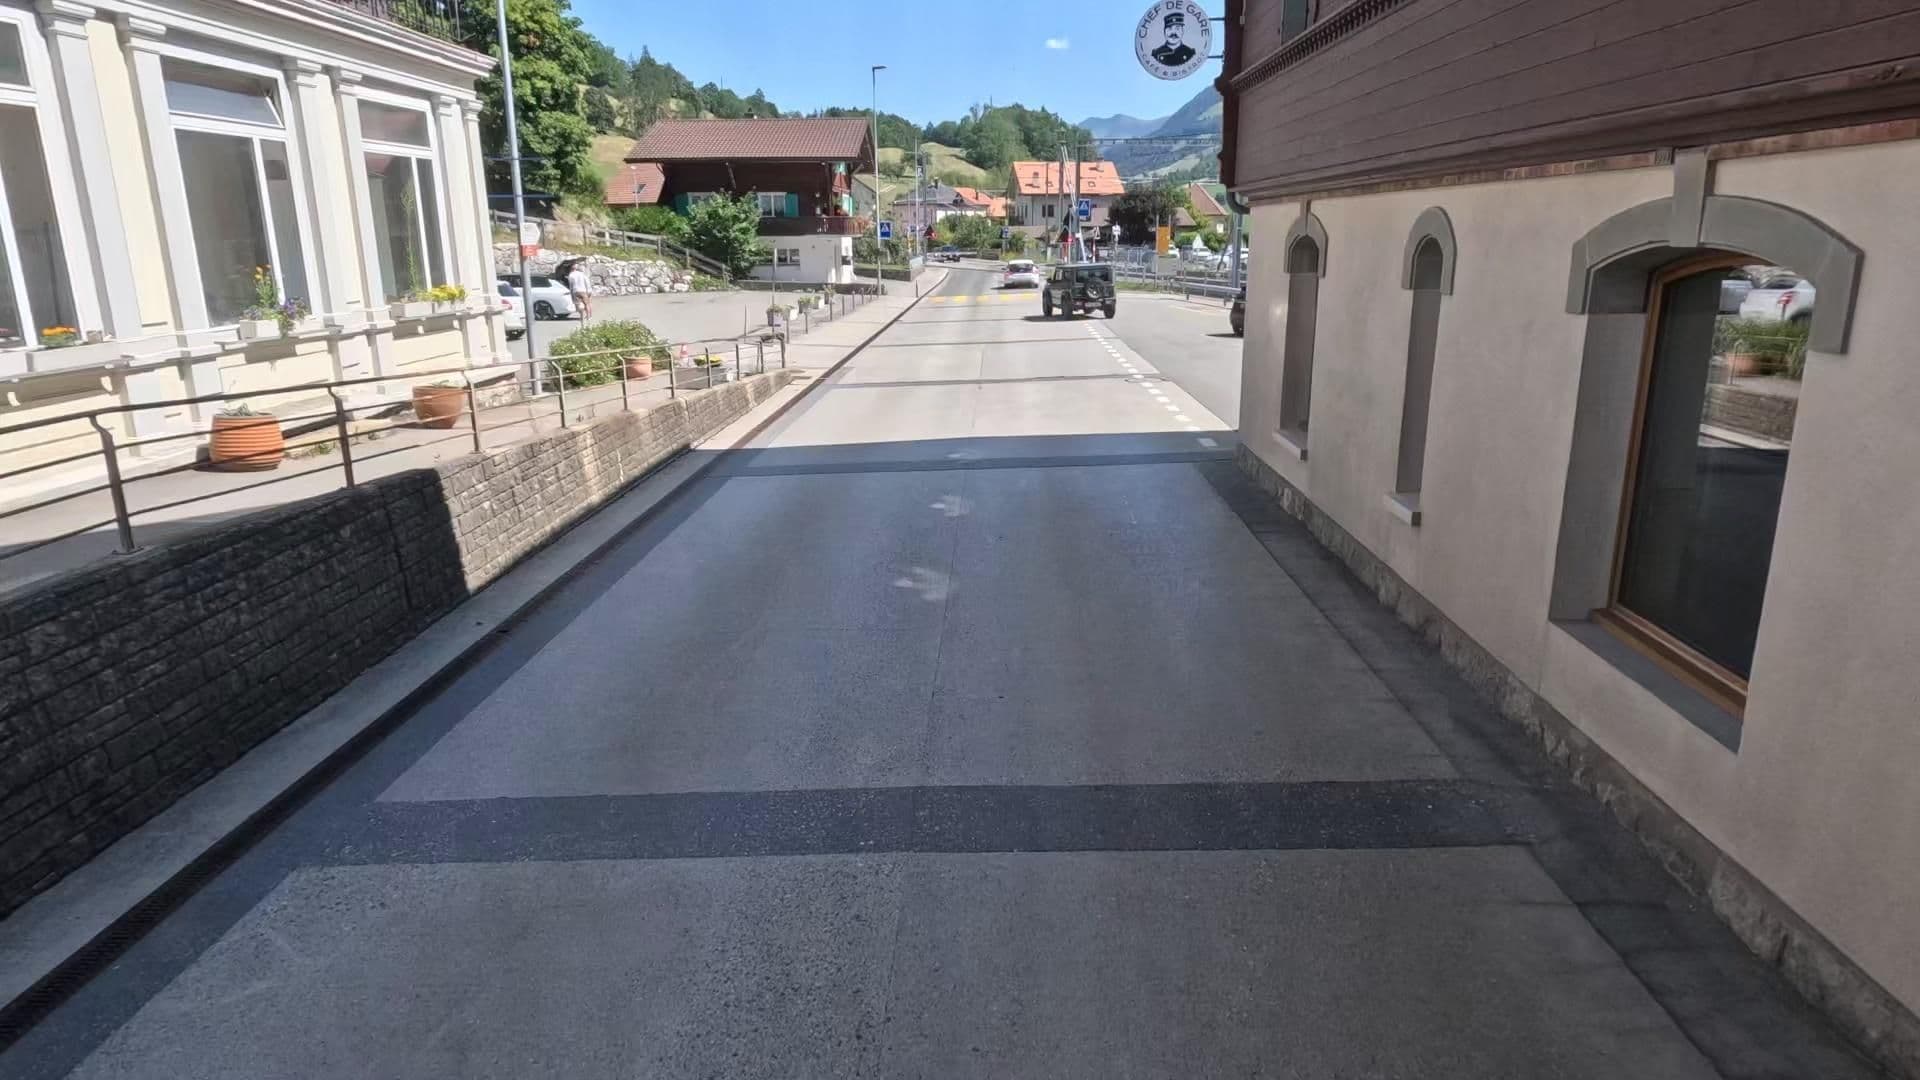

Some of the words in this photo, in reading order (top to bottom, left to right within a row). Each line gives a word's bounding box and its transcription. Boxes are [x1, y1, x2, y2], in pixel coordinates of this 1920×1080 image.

[1139, 5, 1161, 38] CHEF
[1166, 0, 1183, 10] DE
[1186, 4, 1209, 37] GARE
